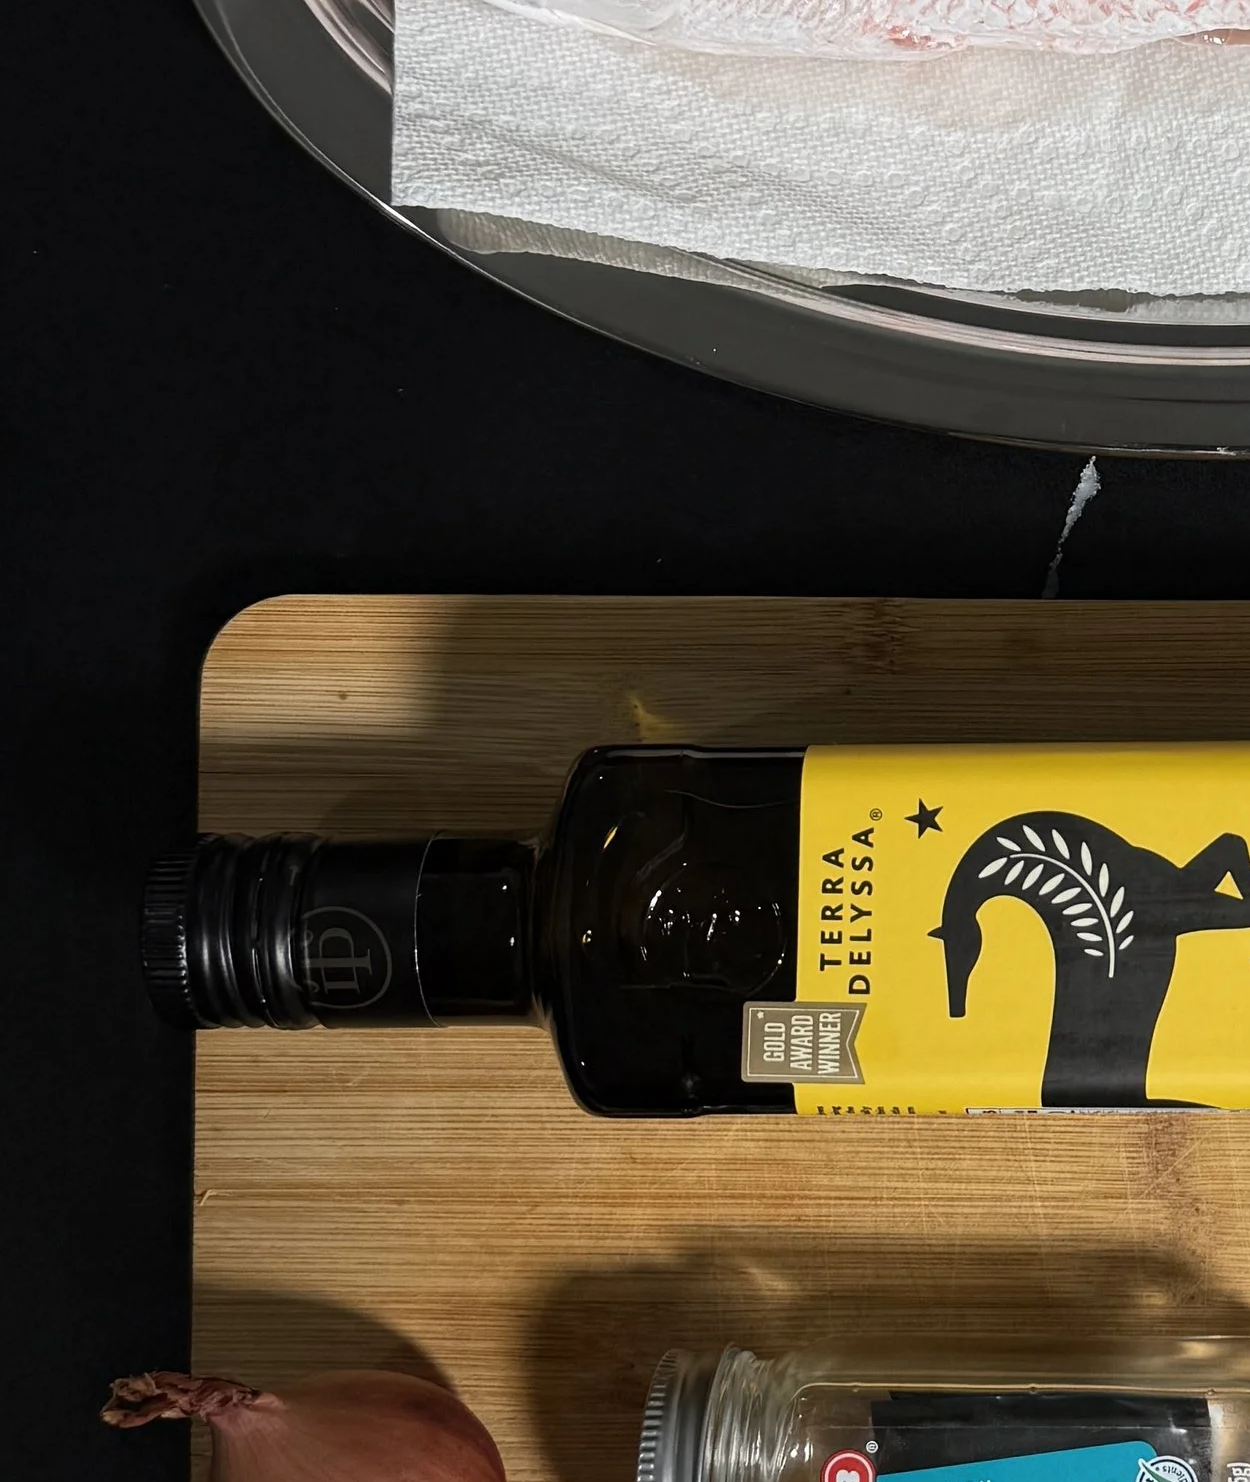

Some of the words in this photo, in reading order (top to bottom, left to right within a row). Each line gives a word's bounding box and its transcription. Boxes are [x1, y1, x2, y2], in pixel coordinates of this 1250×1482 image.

[820, 848, 844, 971] TERRA
[764, 1023, 785, 1062] GOLD
[792, 1016, 814, 1070] AWARD
[819, 1013, 841, 1074] WINNER
